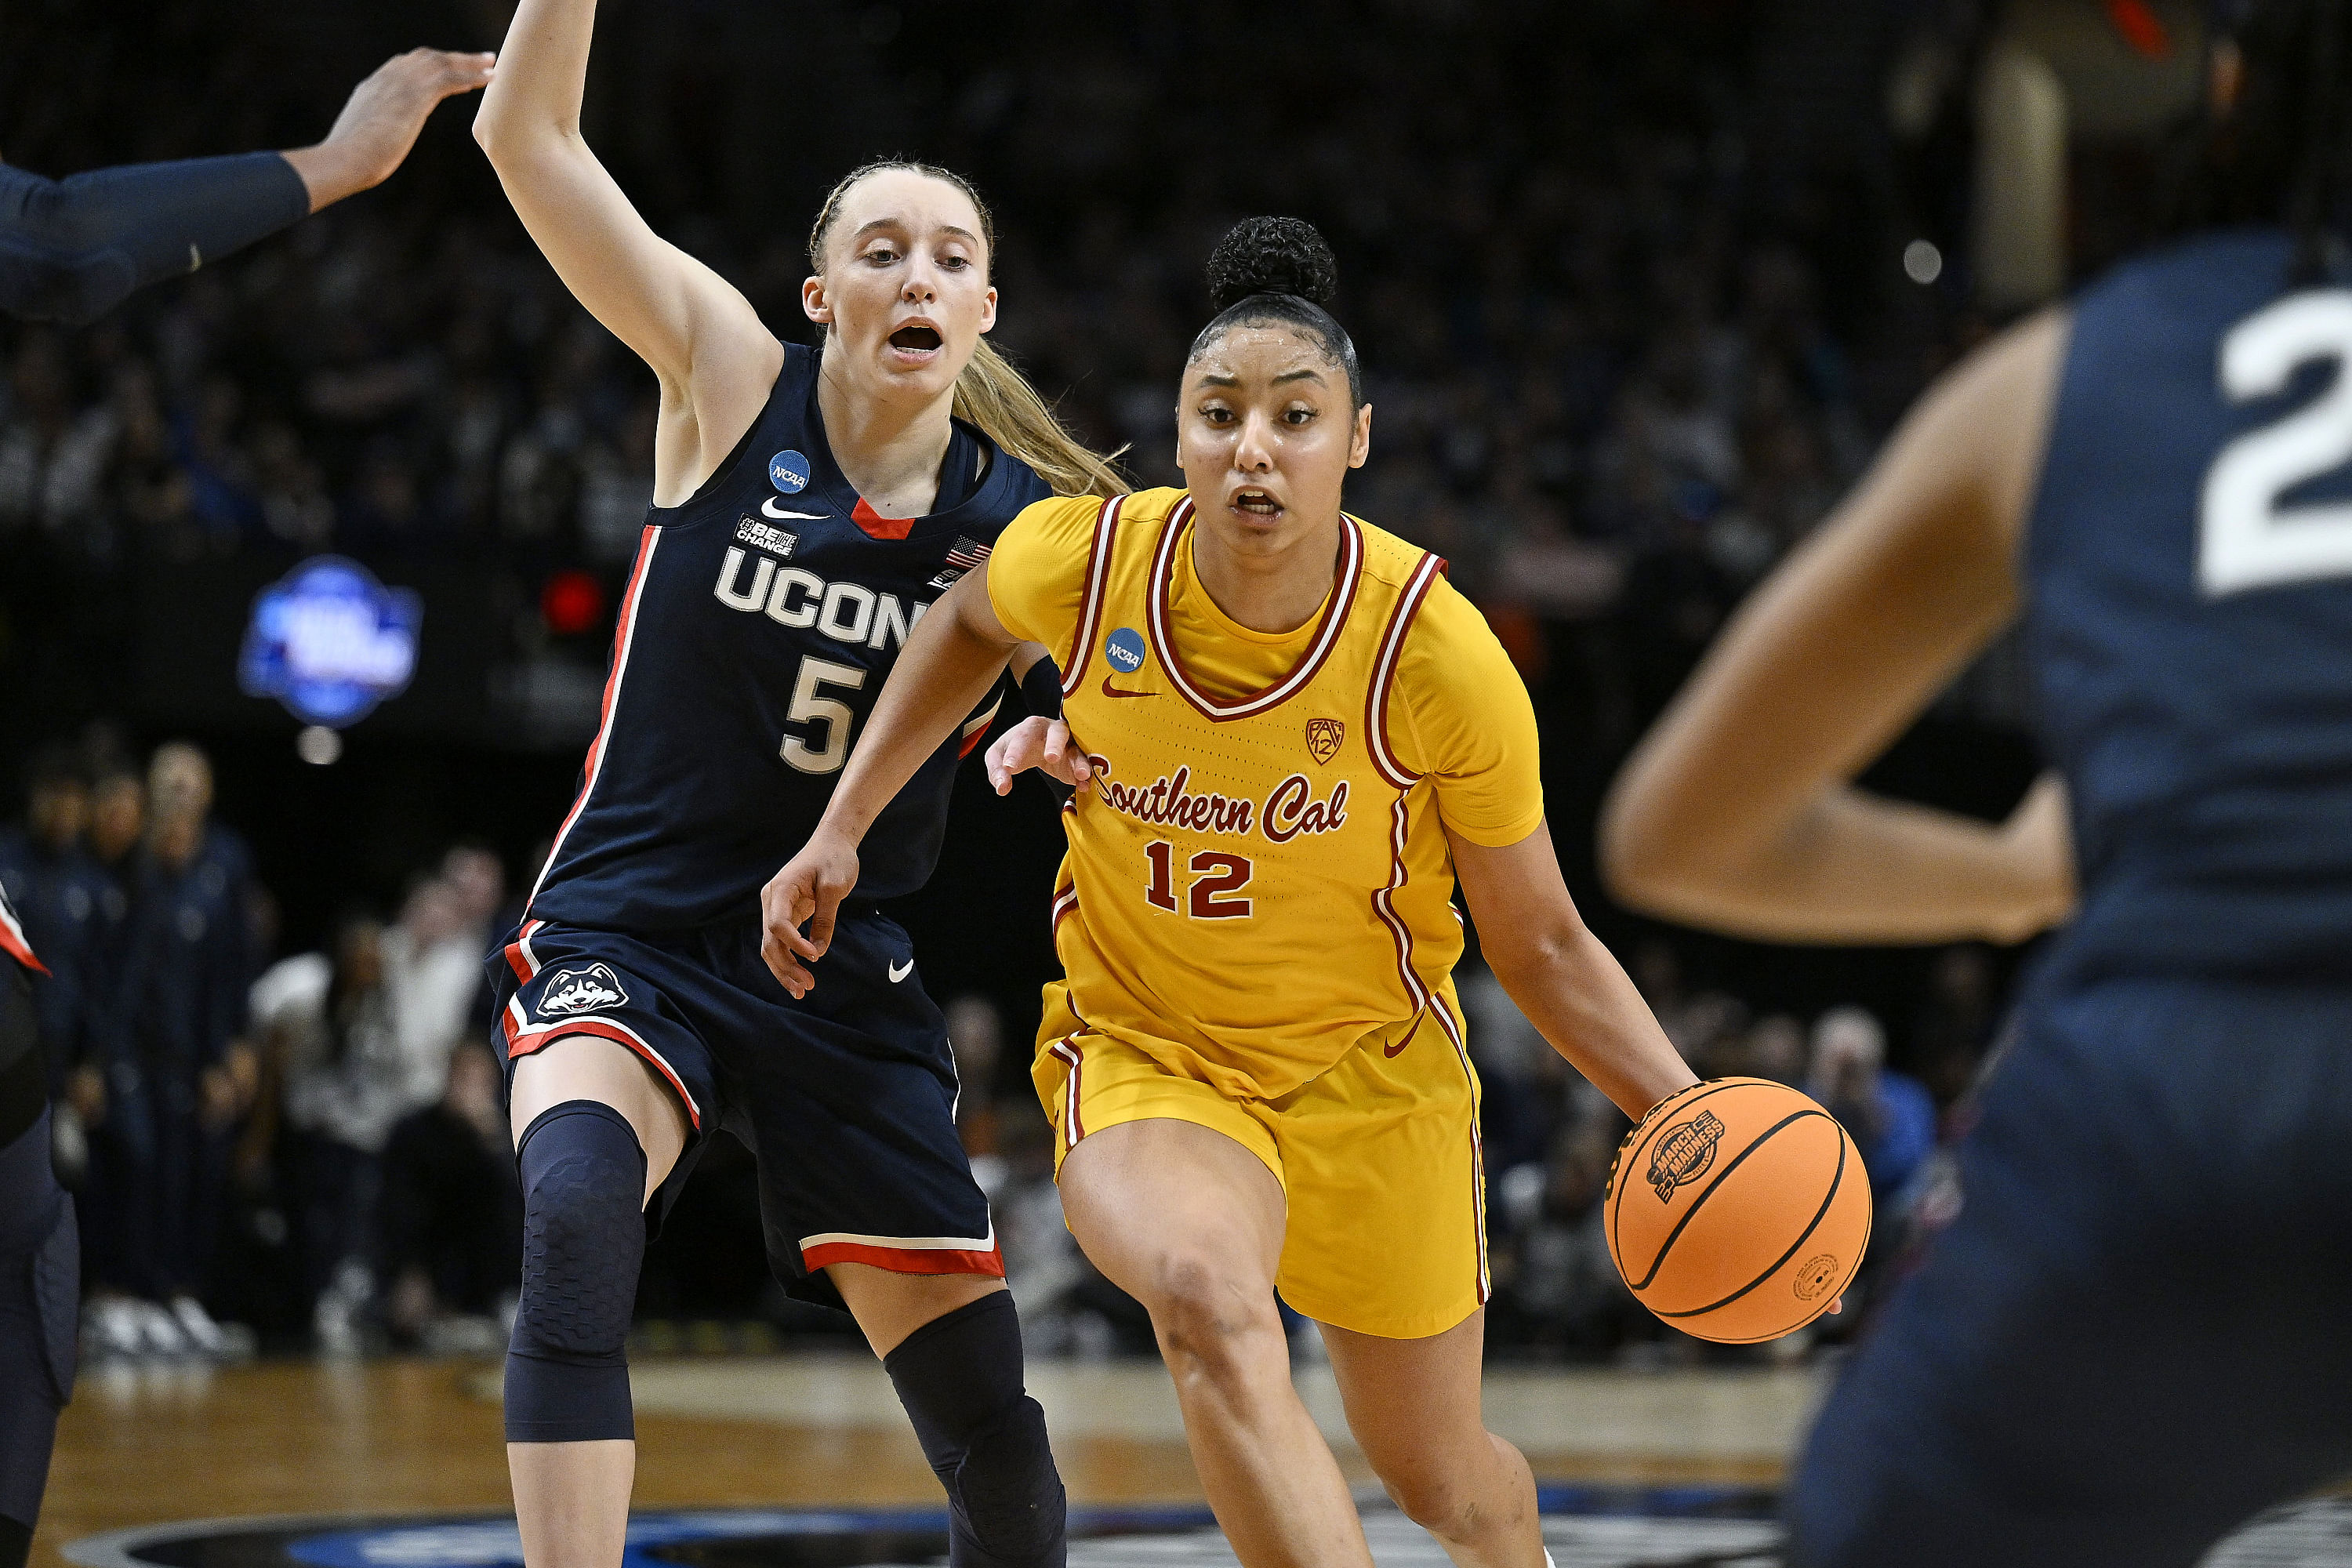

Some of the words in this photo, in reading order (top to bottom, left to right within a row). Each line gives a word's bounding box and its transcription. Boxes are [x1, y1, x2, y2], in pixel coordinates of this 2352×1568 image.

[2198, 287, 2352, 600] 2
[772, 466, 805, 488] NCAA
[737, 529, 793, 556] CHANGE
[714, 546, 930, 651] UCON
[1108, 643, 1140, 667] NCAA
[779, 654, 867, 775] 5
[1314, 739, 1332, 755] 12
[1088, 753, 1255, 834] Southern
[1260, 772, 1350, 844] Cal
[1144, 839, 1254, 919] 12
[1656, 1127, 1696, 1173] MARCH
[1669, 1120, 1724, 1176] MADNESS
